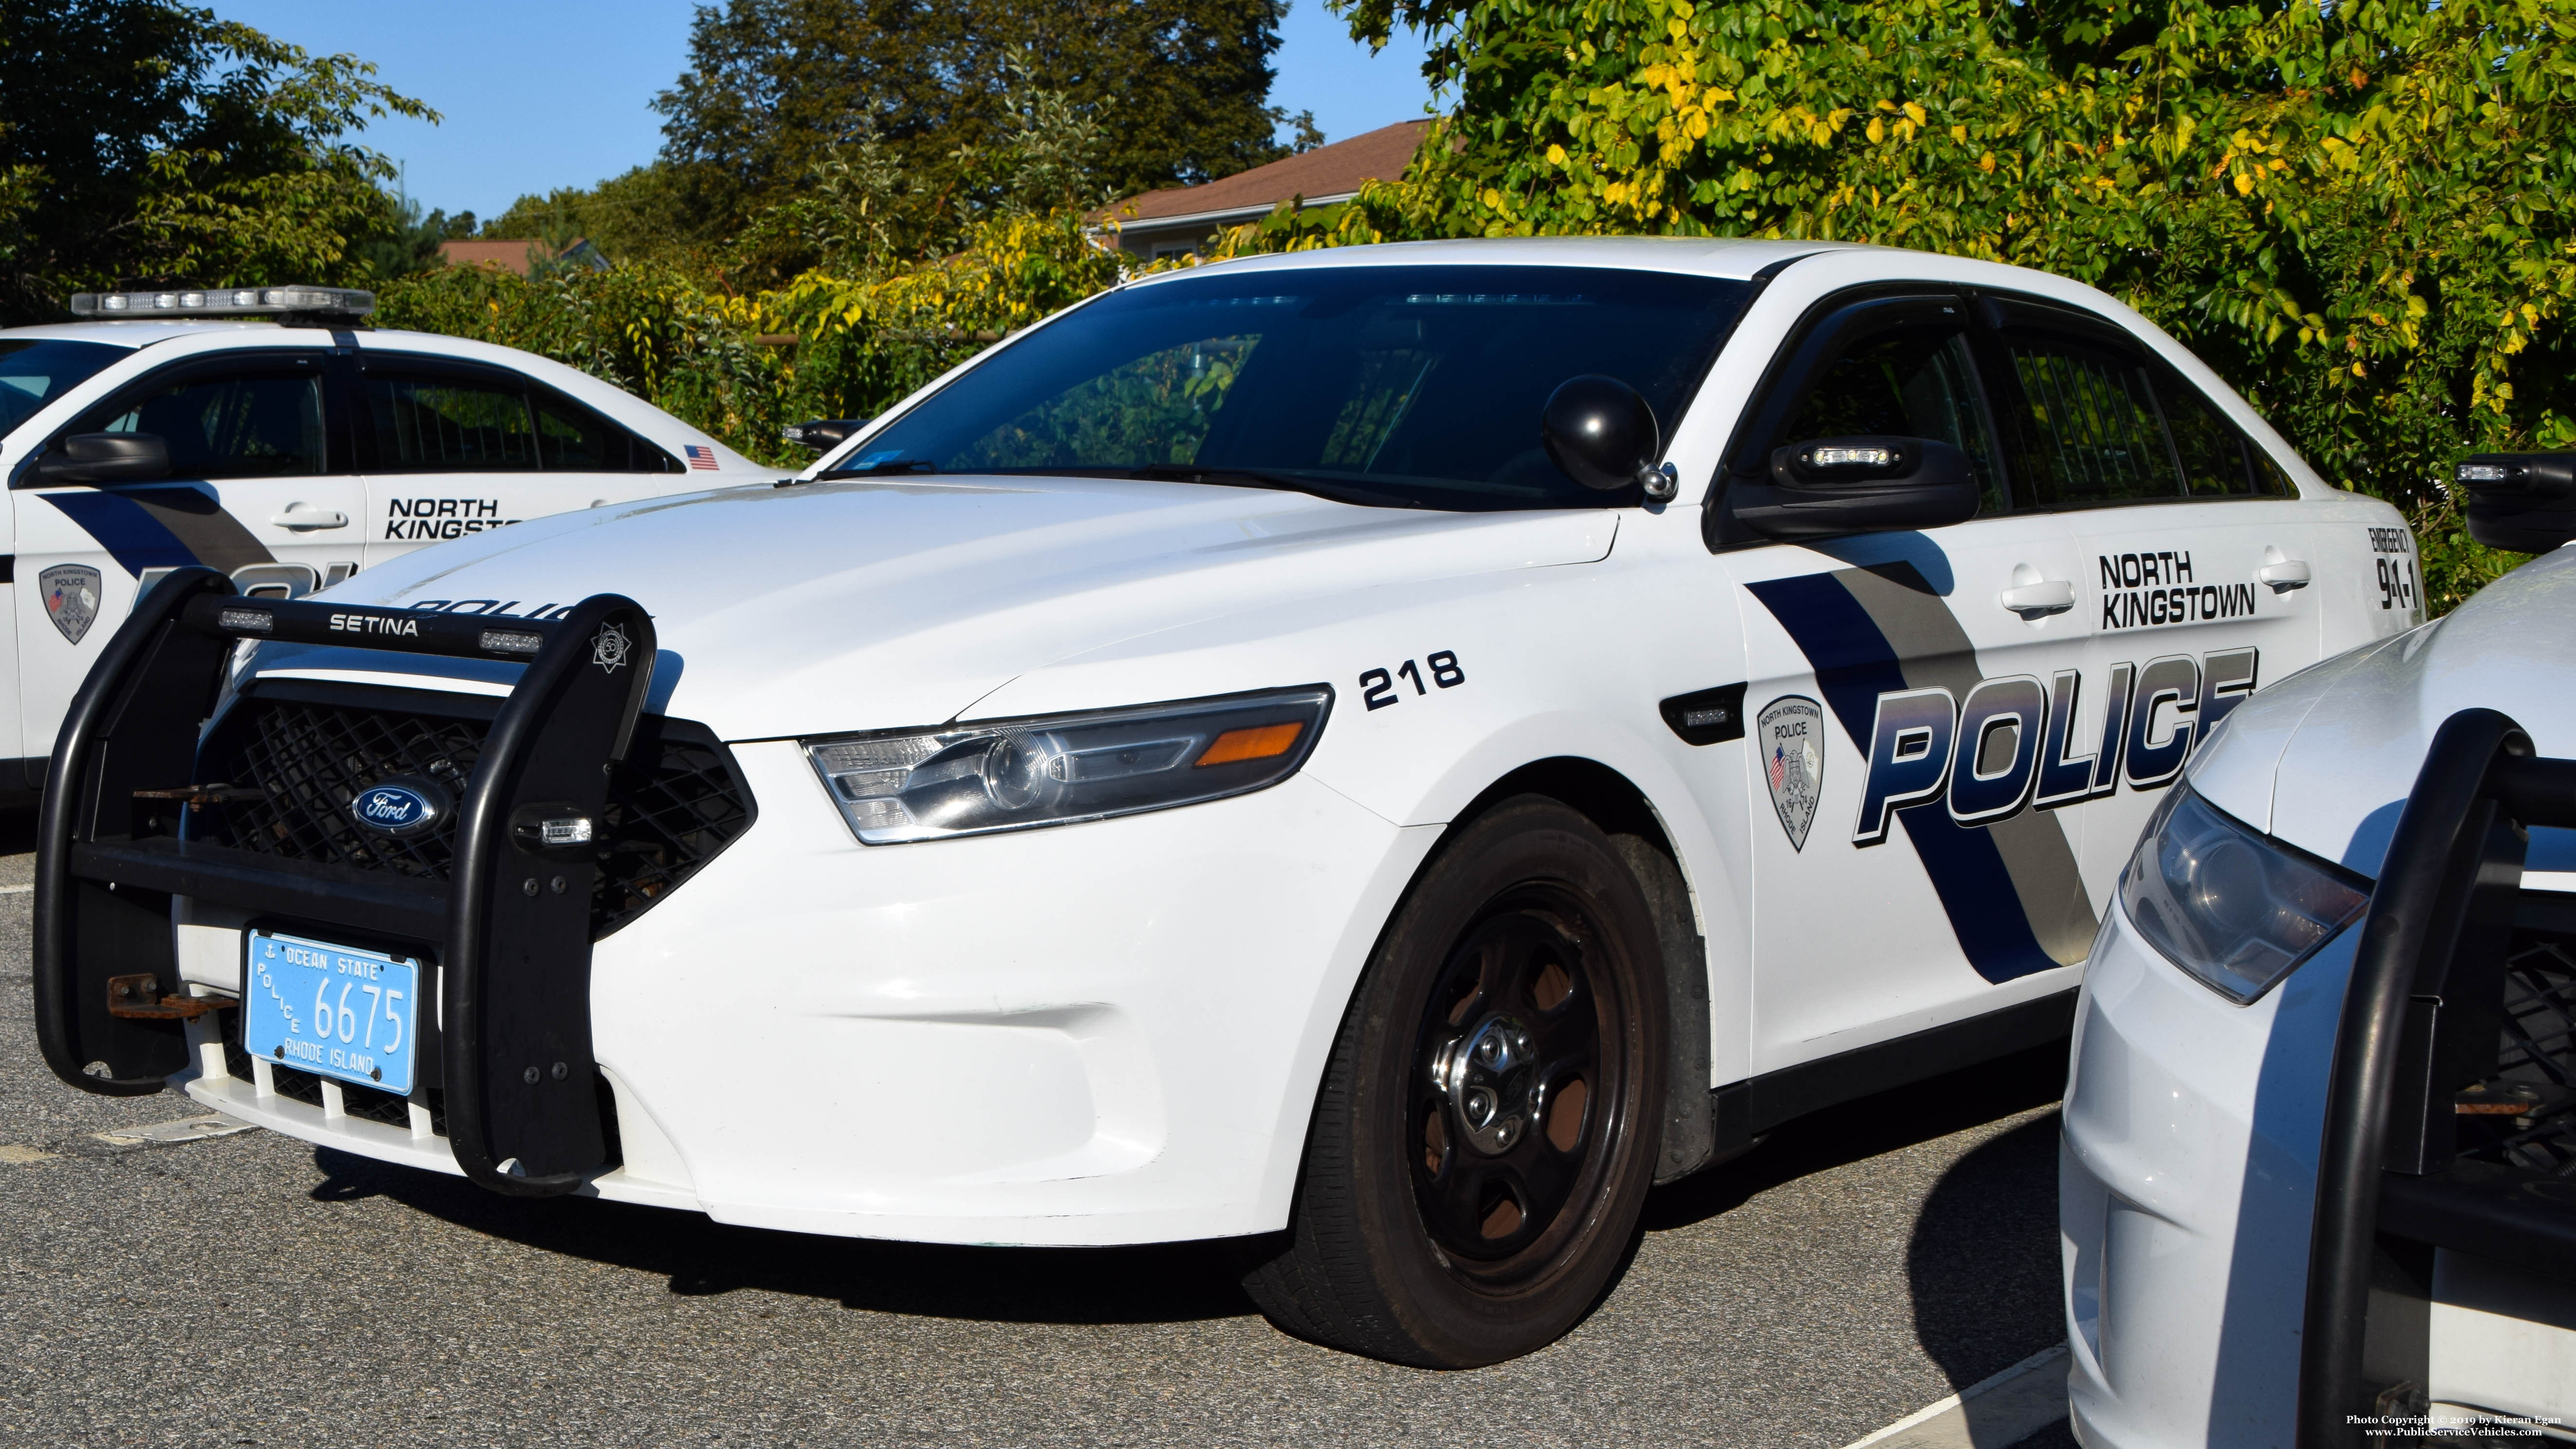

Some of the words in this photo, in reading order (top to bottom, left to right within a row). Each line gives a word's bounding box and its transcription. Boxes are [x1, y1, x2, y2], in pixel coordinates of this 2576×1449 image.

[389, 499, 498, 517] NORTH
[42, 570, 62, 579] NORTH
[63, 569, 97, 578] KINGSTOWN
[55, 578, 86, 586] POLICE
[2099, 551, 2193, 589] NORTH
[2376, 558, 2417, 609] 9-1-1
[2103, 583, 2255, 630] KINGSTOWN
[330, 615, 418, 636] SETINA
[1359, 650, 1465, 712] 218
[1761, 710, 1781, 728] NORTH
[1782, 705, 1819, 719] KINGSTOWN
[1775, 721, 1807, 740] POLICE
[366, 792, 411, 820] Ford
[1780, 803, 1796, 834] RHODE
[1799, 796, 1814, 834] ISLAND
[1786, 798, 1792, 808] 16
[286, 947, 327, 970] OCEAN
[338, 958, 378, 981] STATE
[257, 963, 300, 1033] POLICE
[314, 978, 402, 1055] 6675
[284, 1037, 323, 1064] RHODE
[330, 1049, 374, 1075] ISLAND
